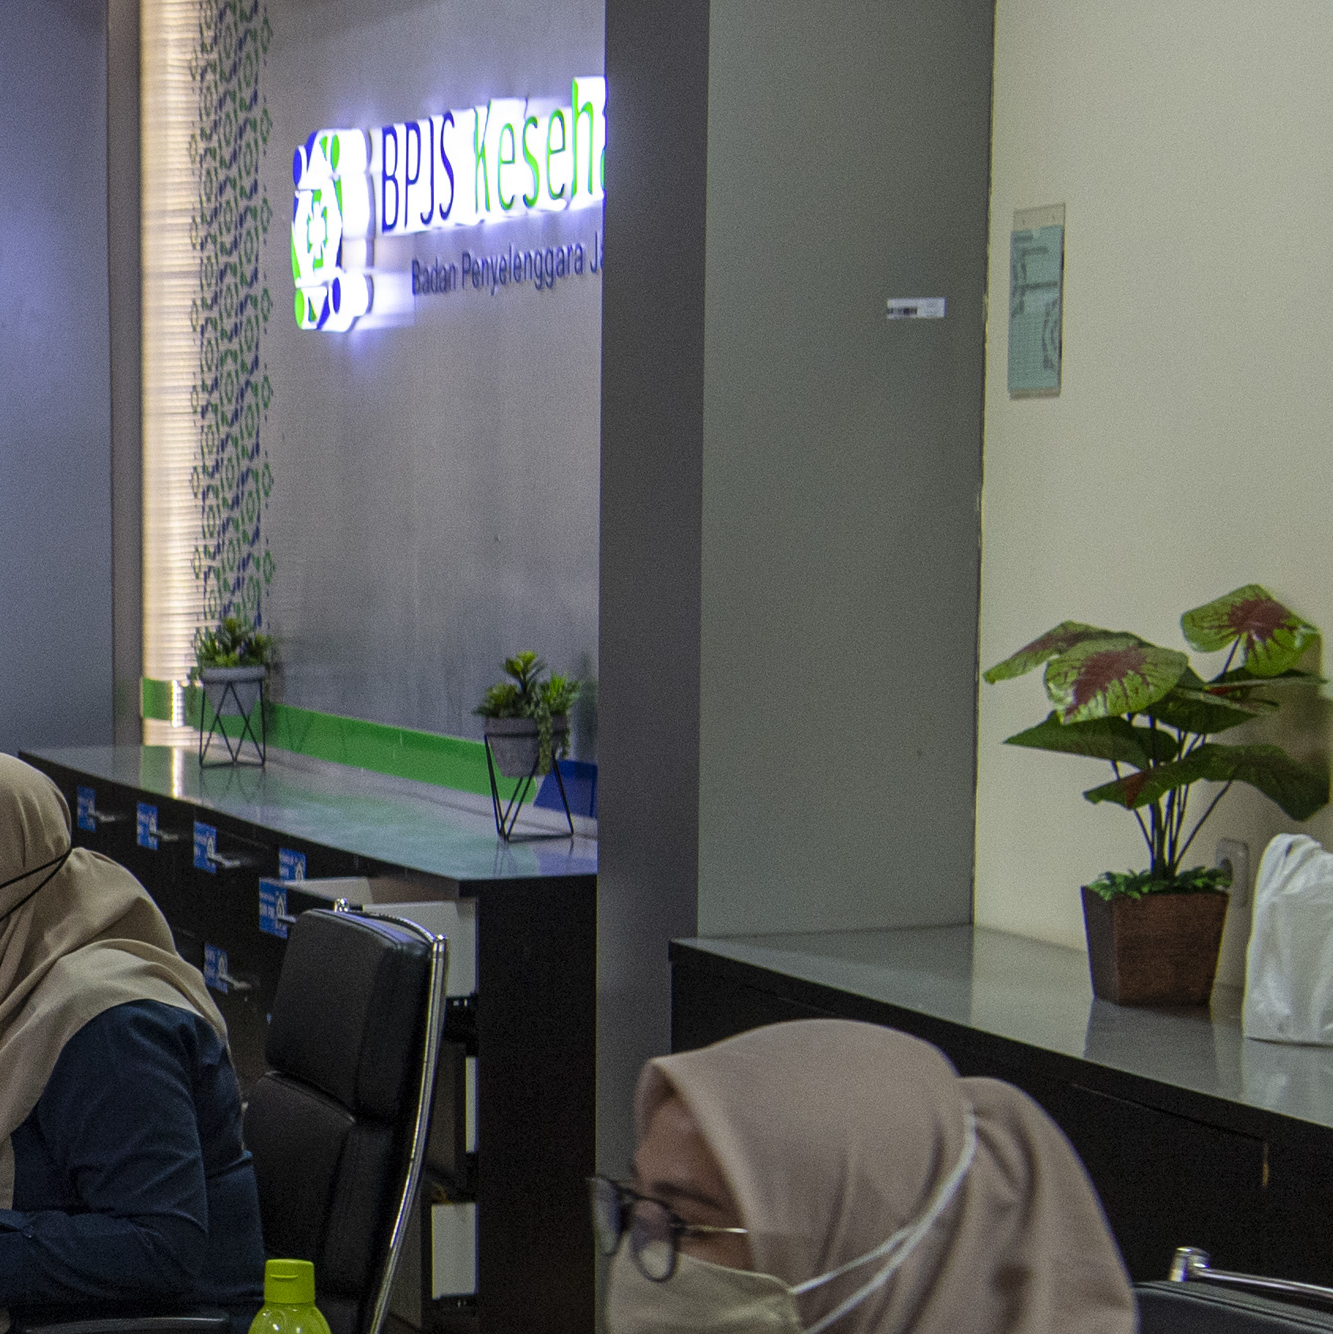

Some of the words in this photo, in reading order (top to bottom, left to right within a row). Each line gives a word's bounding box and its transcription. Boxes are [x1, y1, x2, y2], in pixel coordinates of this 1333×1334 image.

[382, 110, 455, 235] BPJS
[474, 77, 606, 214] Keseh
[411, 254, 457, 296] Badan
[461, 242, 584, 296] Penyelenggara
[590, 230, 604, 274] J
